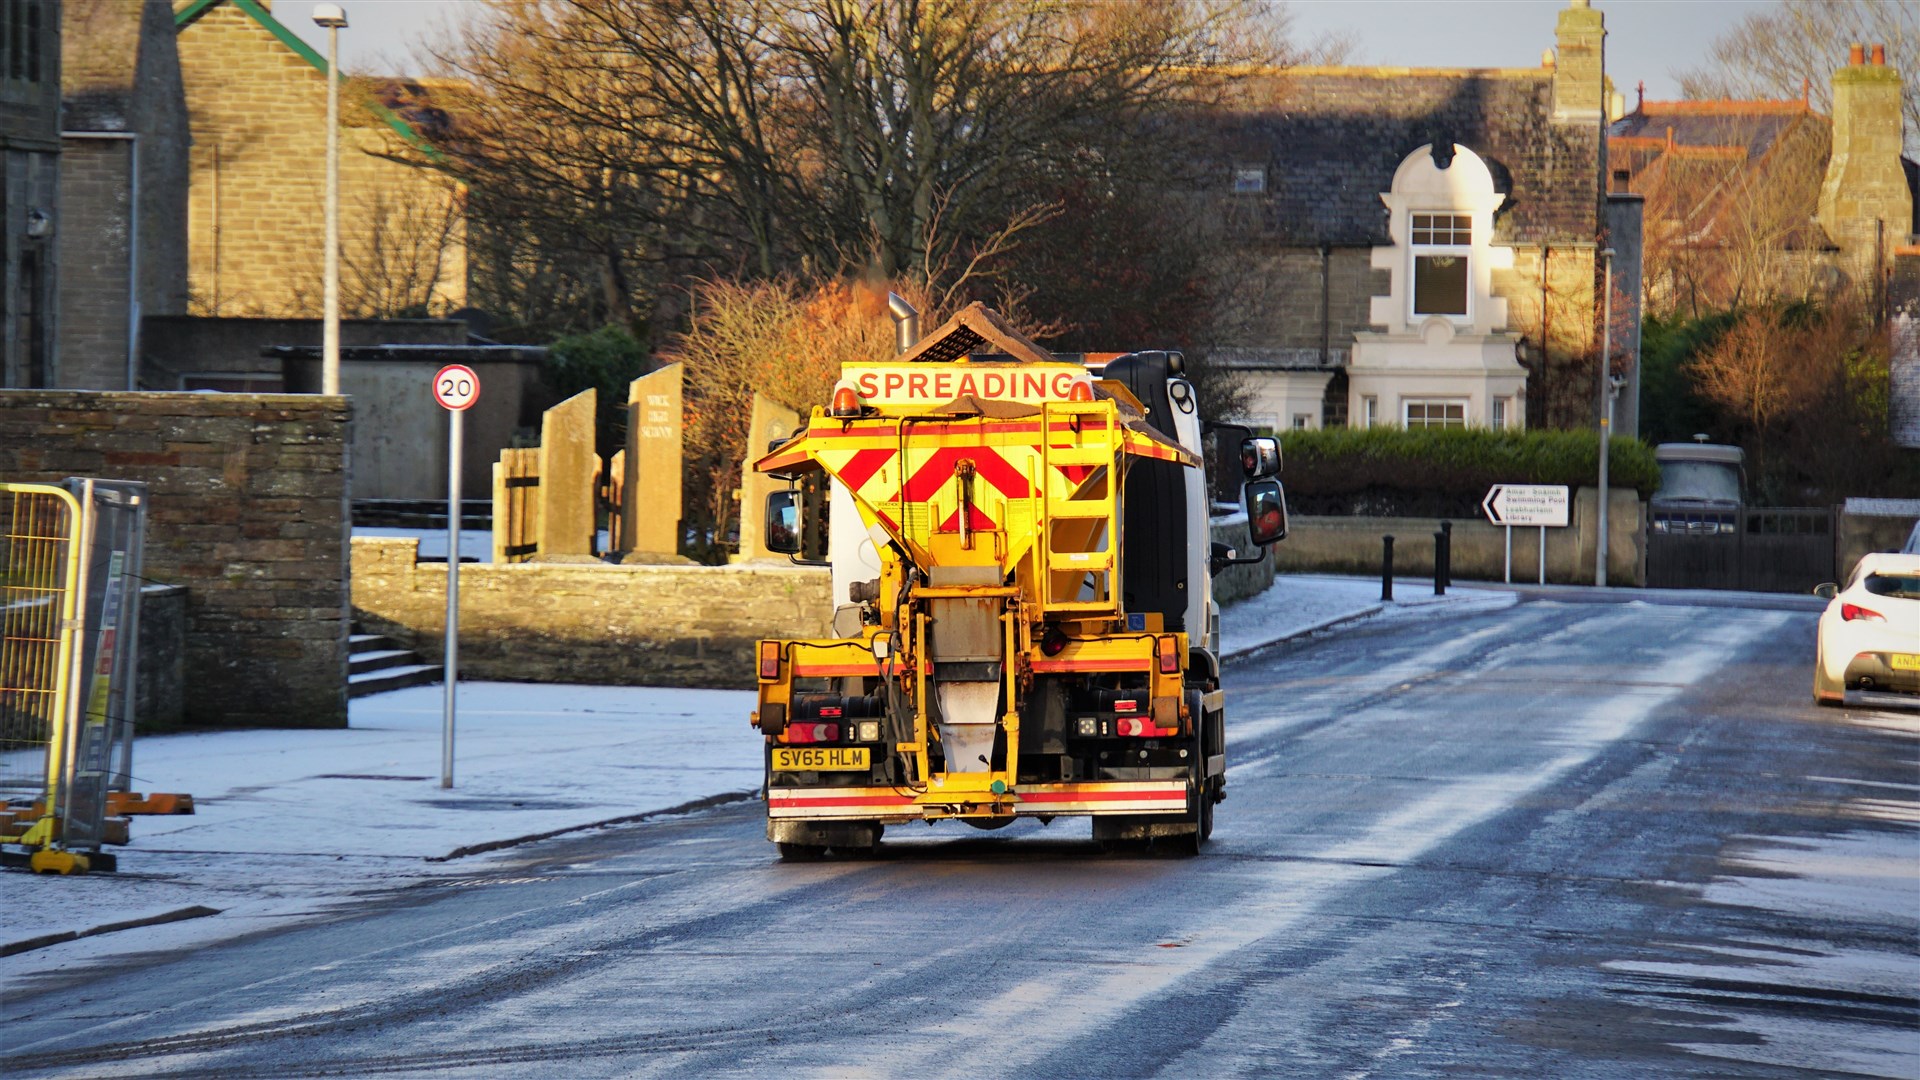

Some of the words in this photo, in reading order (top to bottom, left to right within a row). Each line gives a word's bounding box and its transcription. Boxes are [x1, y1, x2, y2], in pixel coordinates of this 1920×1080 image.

[442, 379, 471, 397] 20
[859, 373, 1073, 398] SPREADING
[1506, 496, 1546, 504] Swimming
[1505, 514, 1532, 522] Library
[780, 750, 825, 767] SV65
[829, 750, 863, 766] HLM
